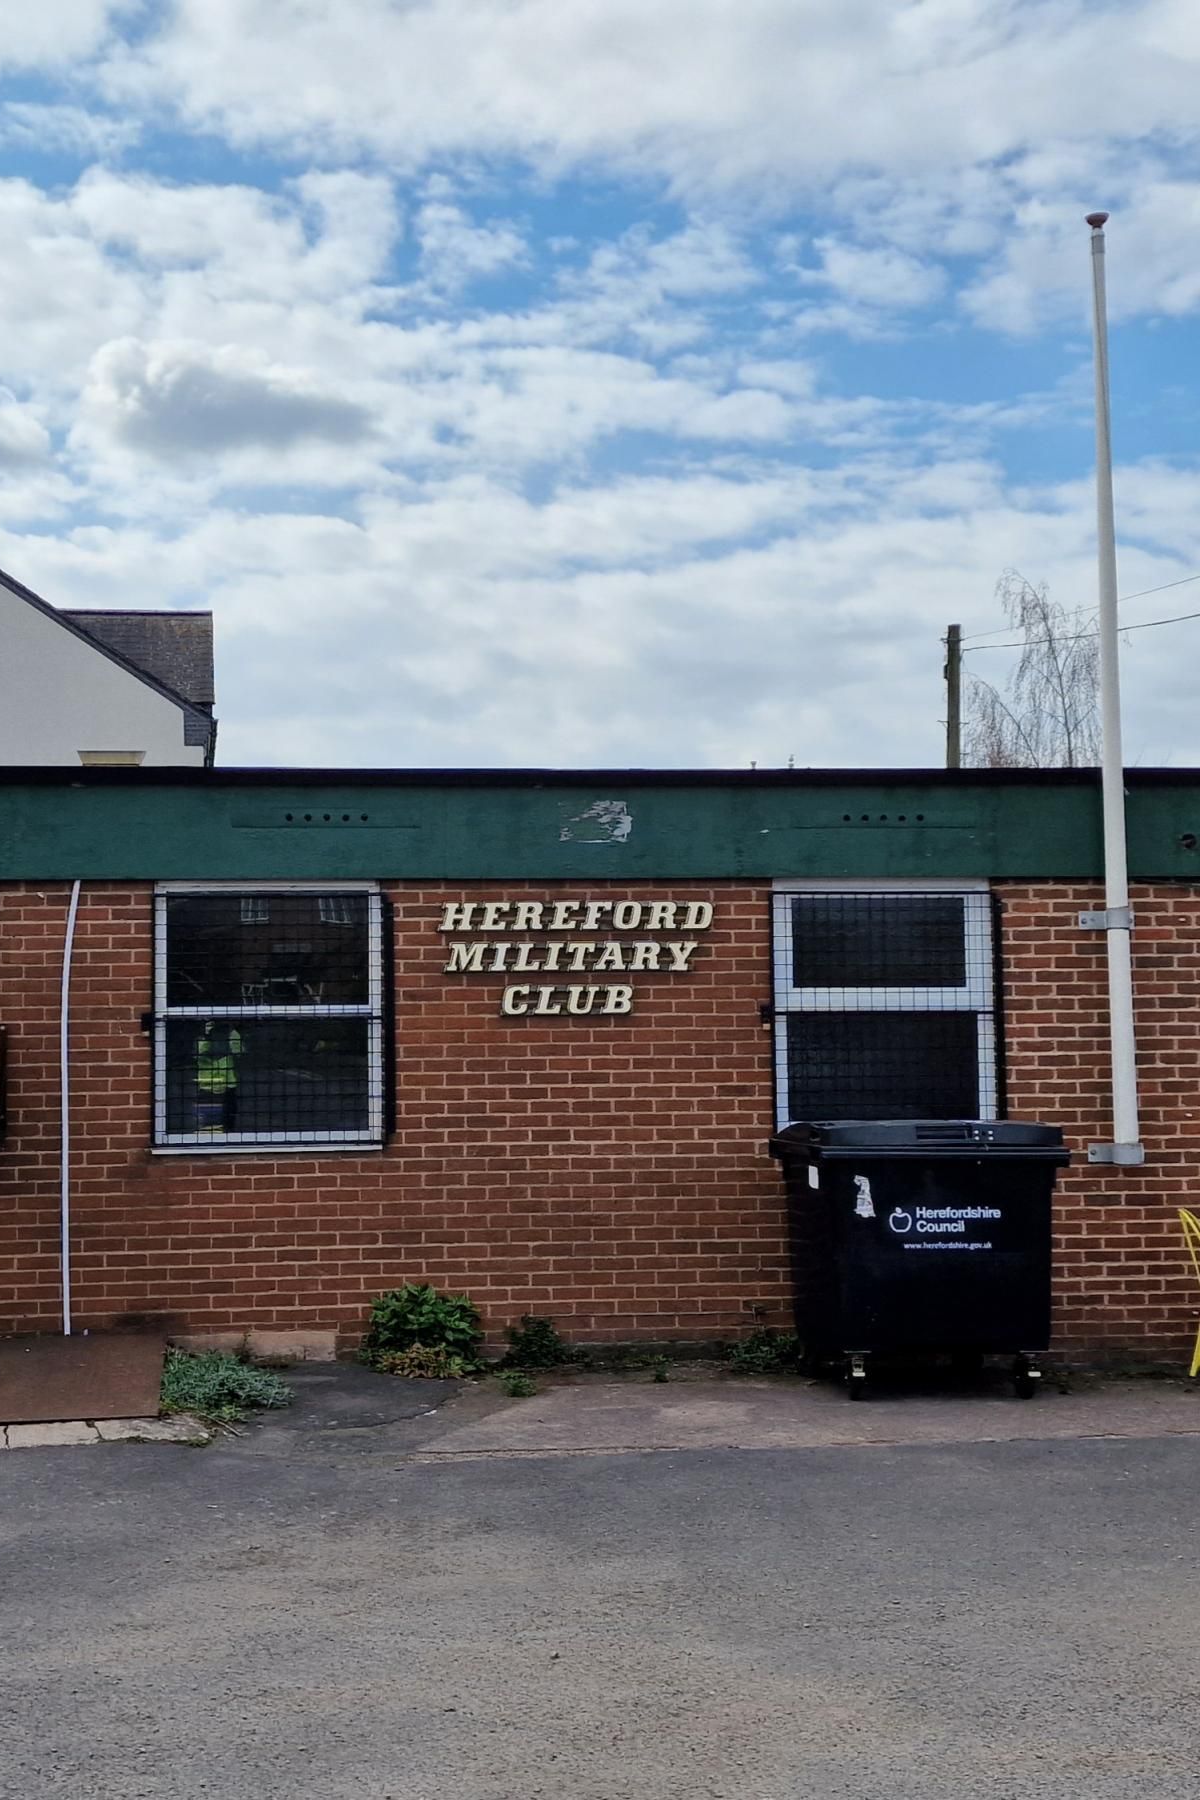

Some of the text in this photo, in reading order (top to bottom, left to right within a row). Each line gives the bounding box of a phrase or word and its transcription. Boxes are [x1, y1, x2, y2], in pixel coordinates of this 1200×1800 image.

[438, 901, 714, 931] HEREFORD
[445, 941, 698, 972] MILITARY
[501, 984, 634, 1015] CLUB
[915, 1206, 1002, 1219] Herefordshire
[916, 1220, 965, 1233] Council
[903, 1242, 992, 1250] www.herefordshire.gov.uk
